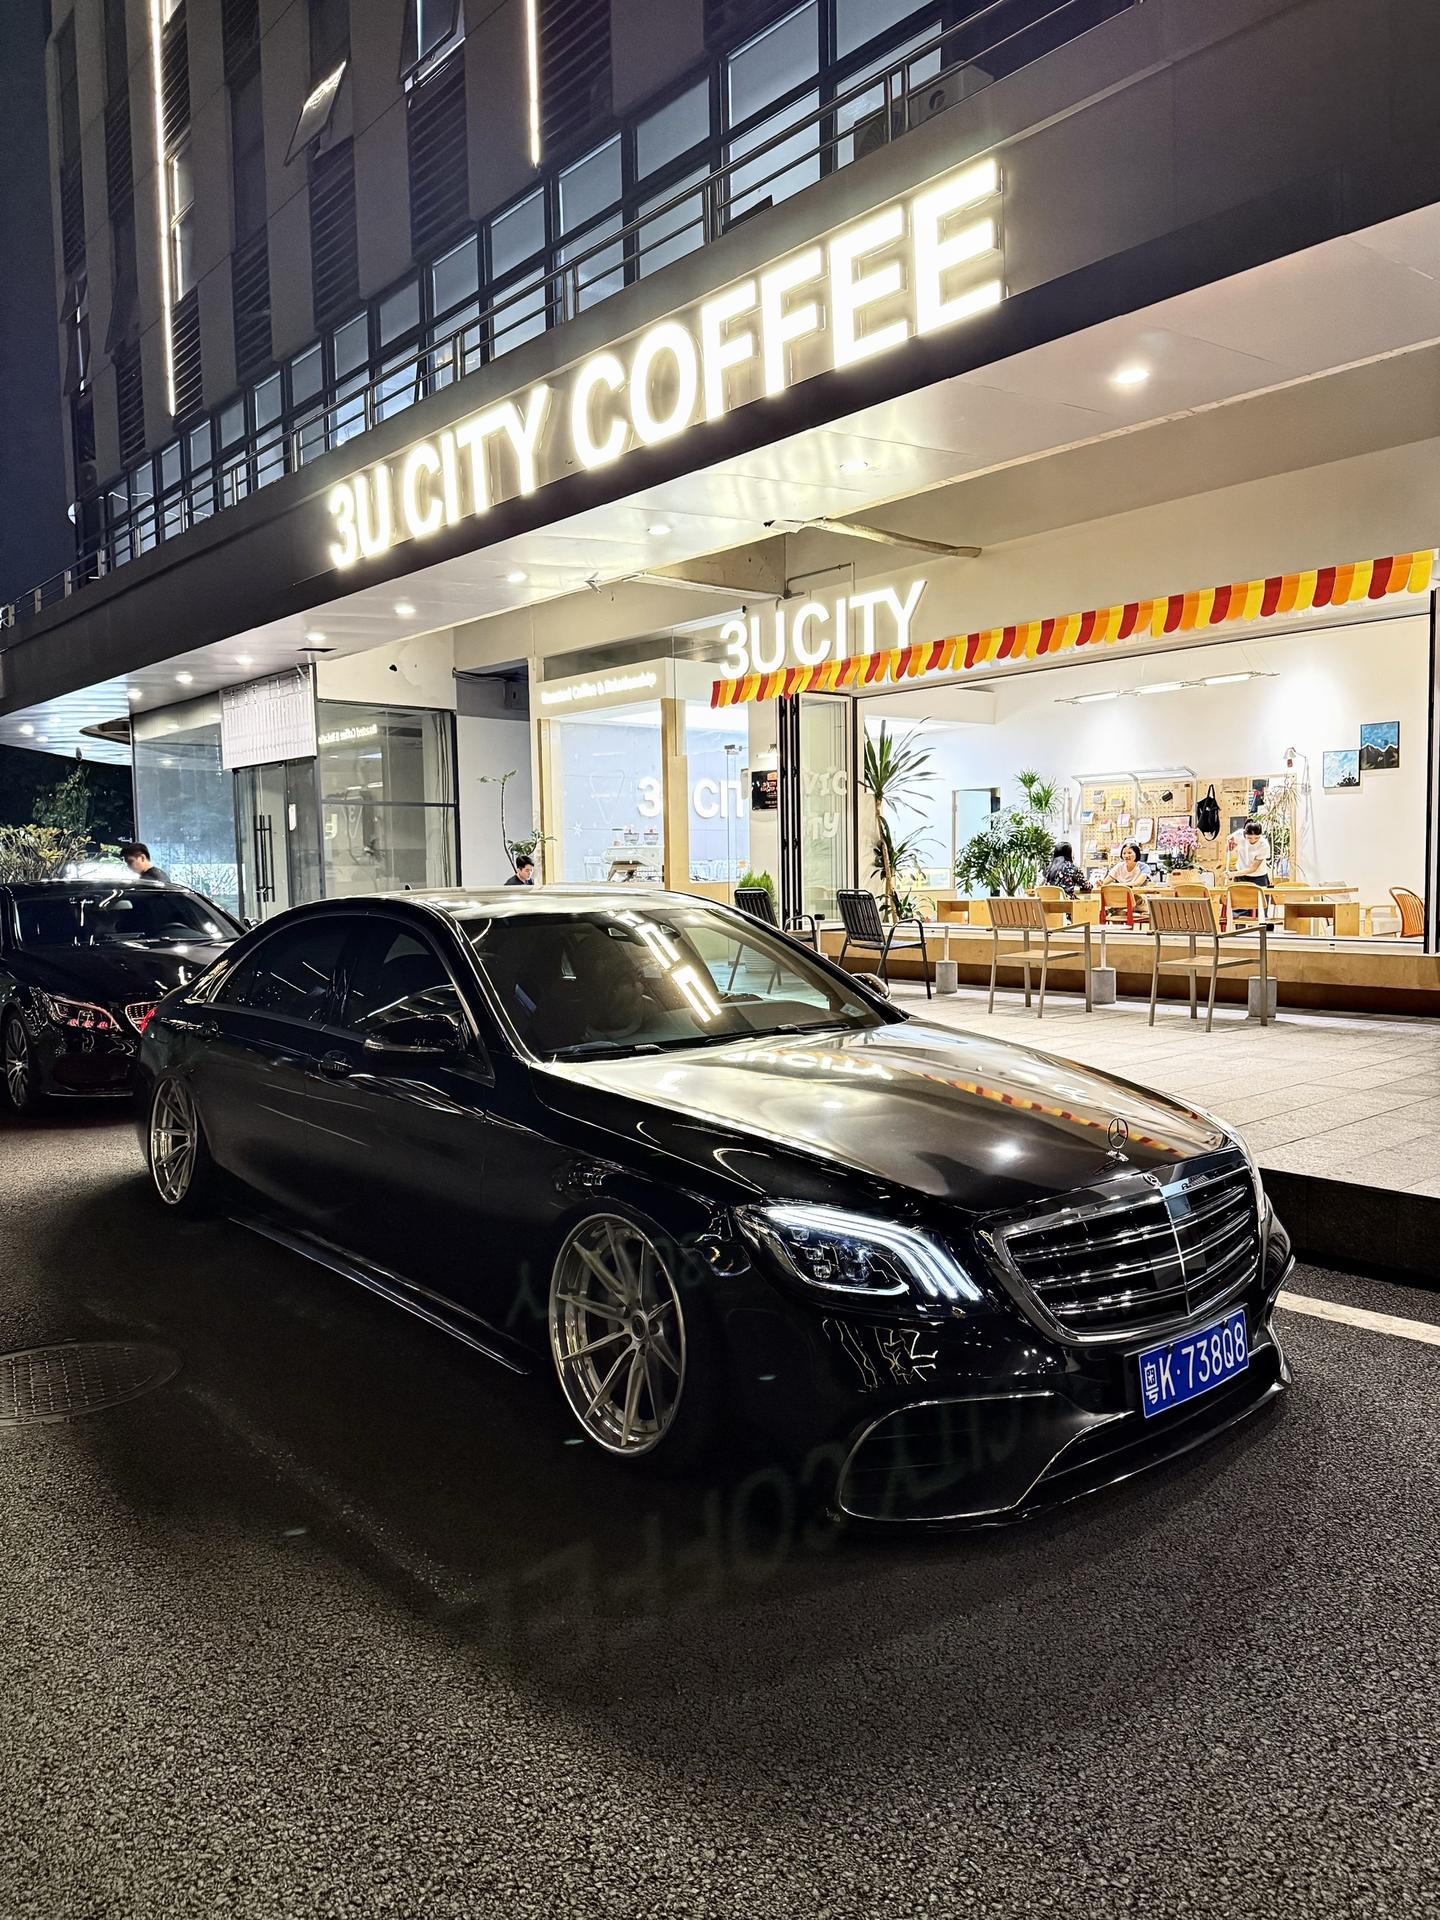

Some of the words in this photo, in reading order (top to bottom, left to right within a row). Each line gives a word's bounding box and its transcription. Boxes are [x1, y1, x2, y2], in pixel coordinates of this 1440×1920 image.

[329, 464, 394, 568] 3U
[402, 386, 552, 538] CITY
[571, 159, 1002, 470] COFFEE
[637, 776, 663, 818] 3
[692, 776, 746, 819] CIT
